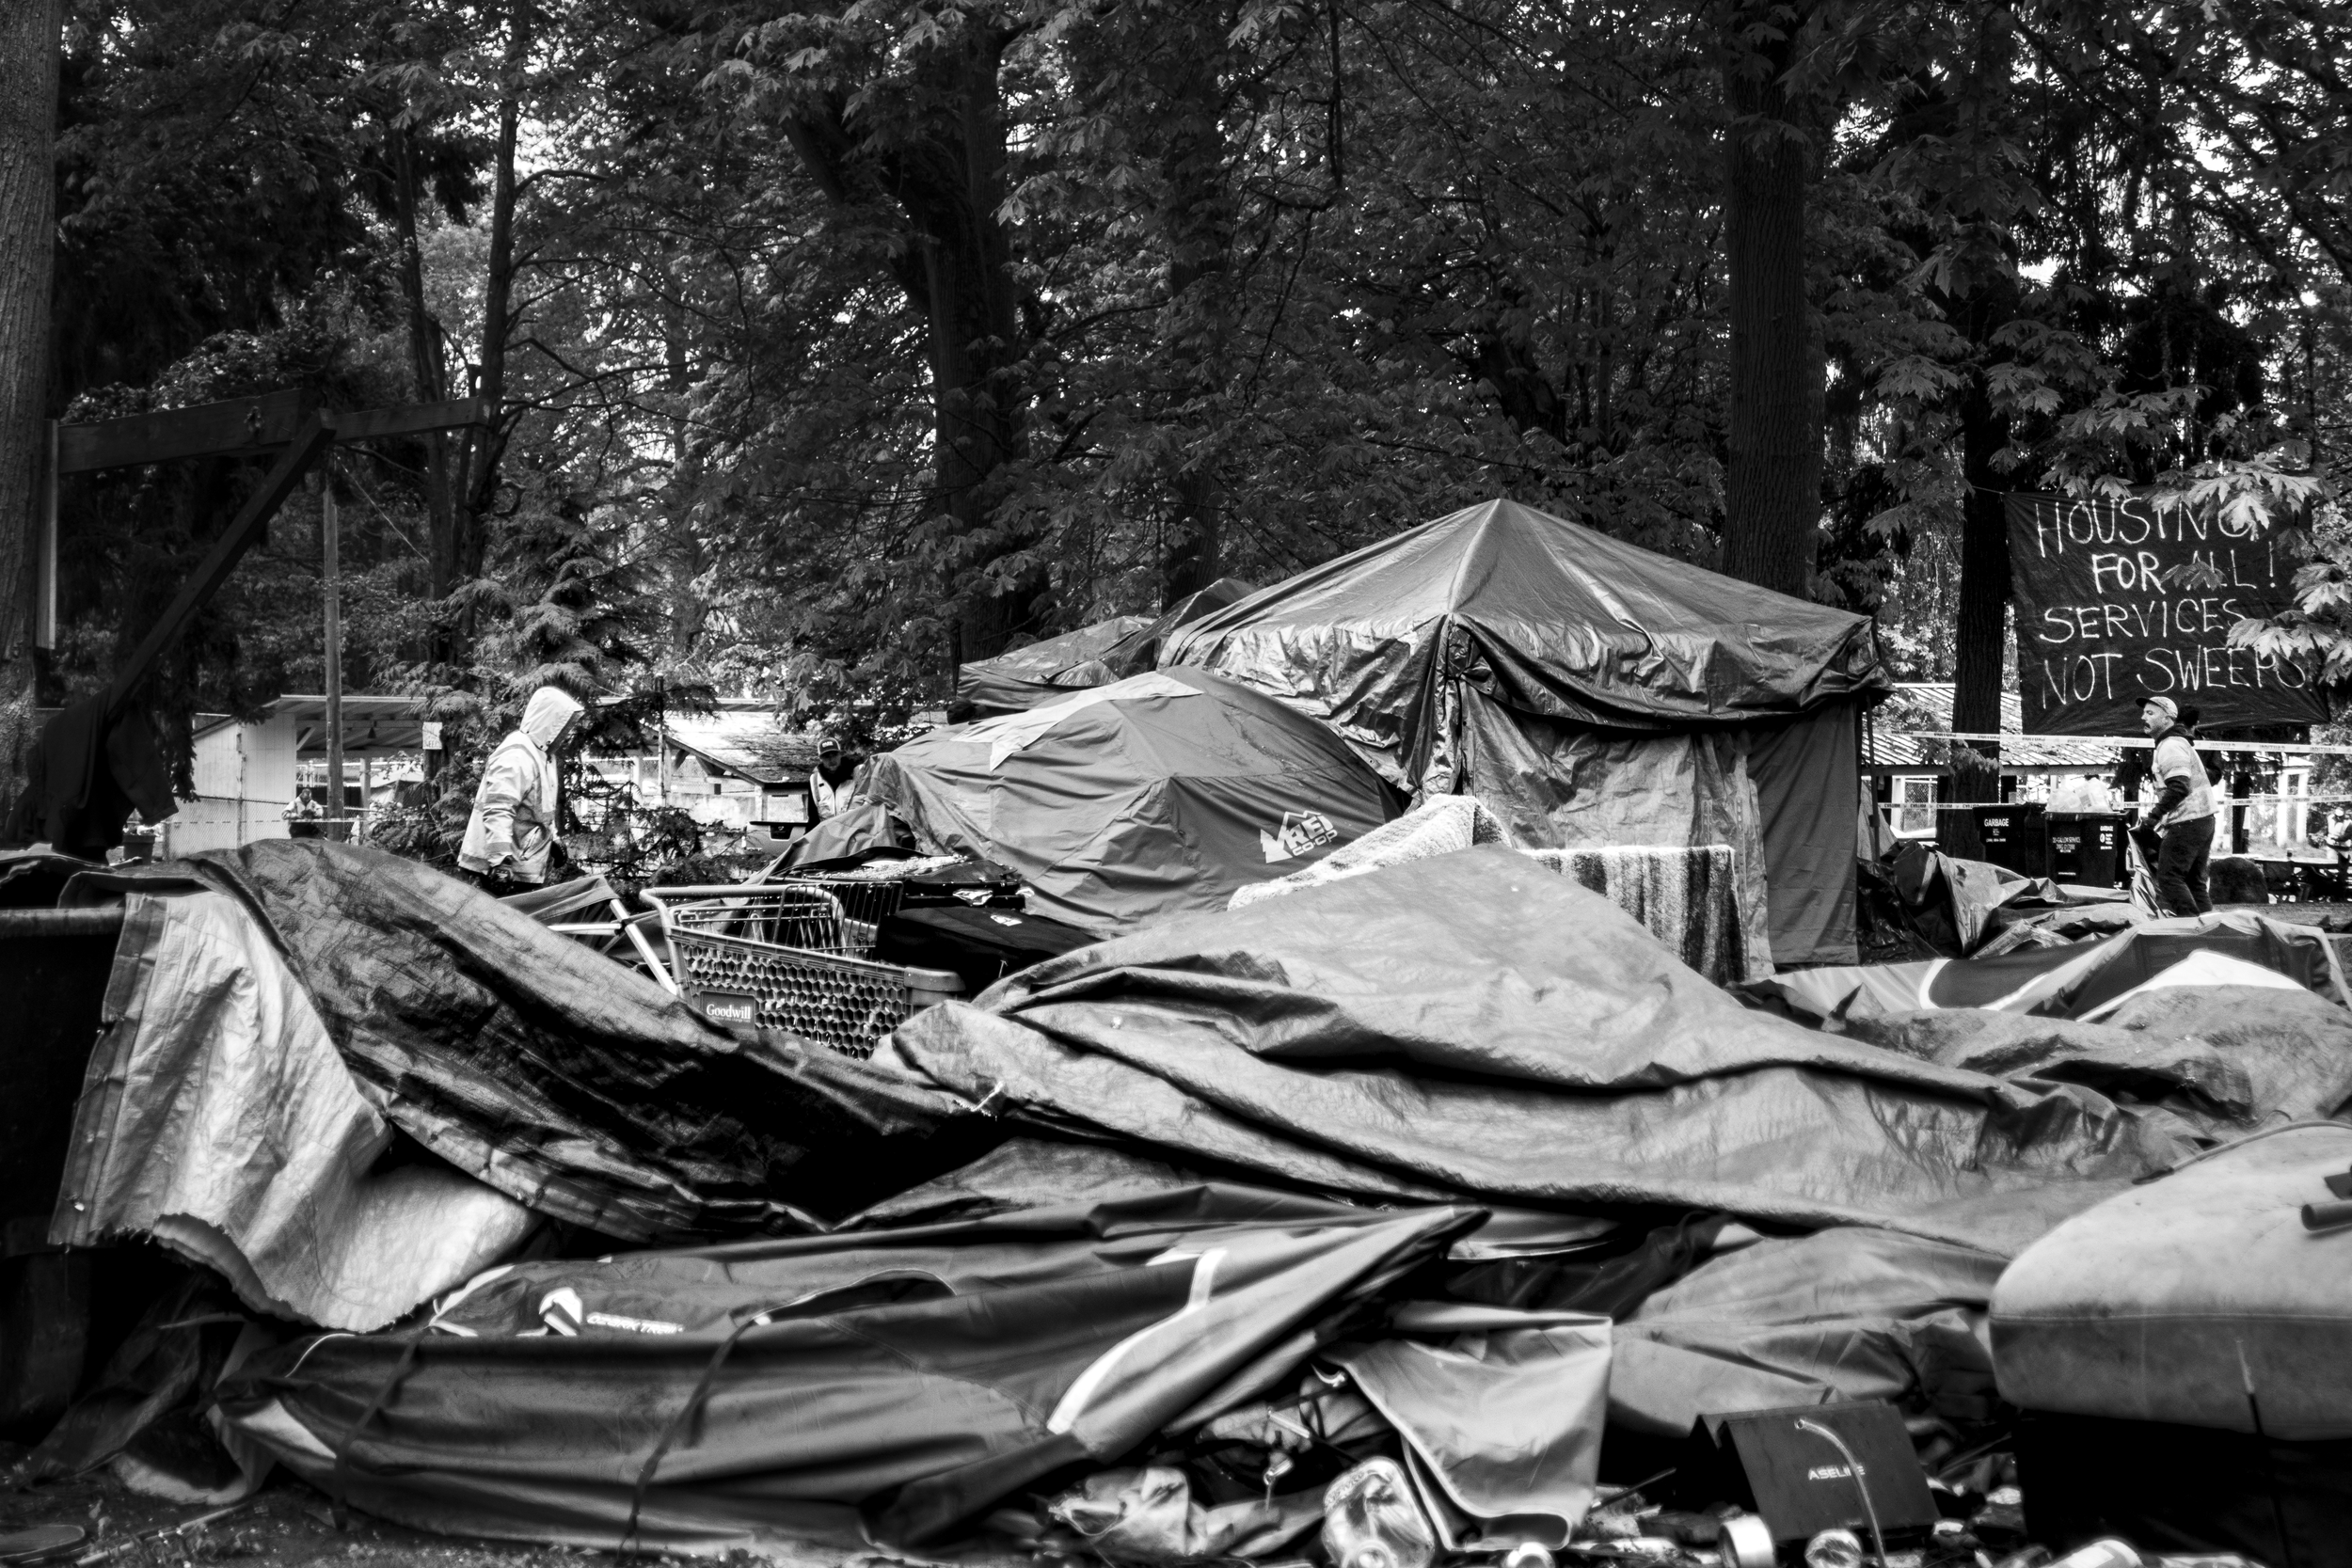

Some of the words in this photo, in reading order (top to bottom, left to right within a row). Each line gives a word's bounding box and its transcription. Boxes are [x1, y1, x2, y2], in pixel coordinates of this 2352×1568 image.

[2091, 551, 2166, 594] FOR
[2042, 653, 2123, 710] NOT
[1284, 815, 1334, 850] REI
[1983, 817, 2010, 827] GARBAGE
[707, 1004, 751, 1019] Goodwill
[1807, 1464, 1867, 1481] ASELIE
